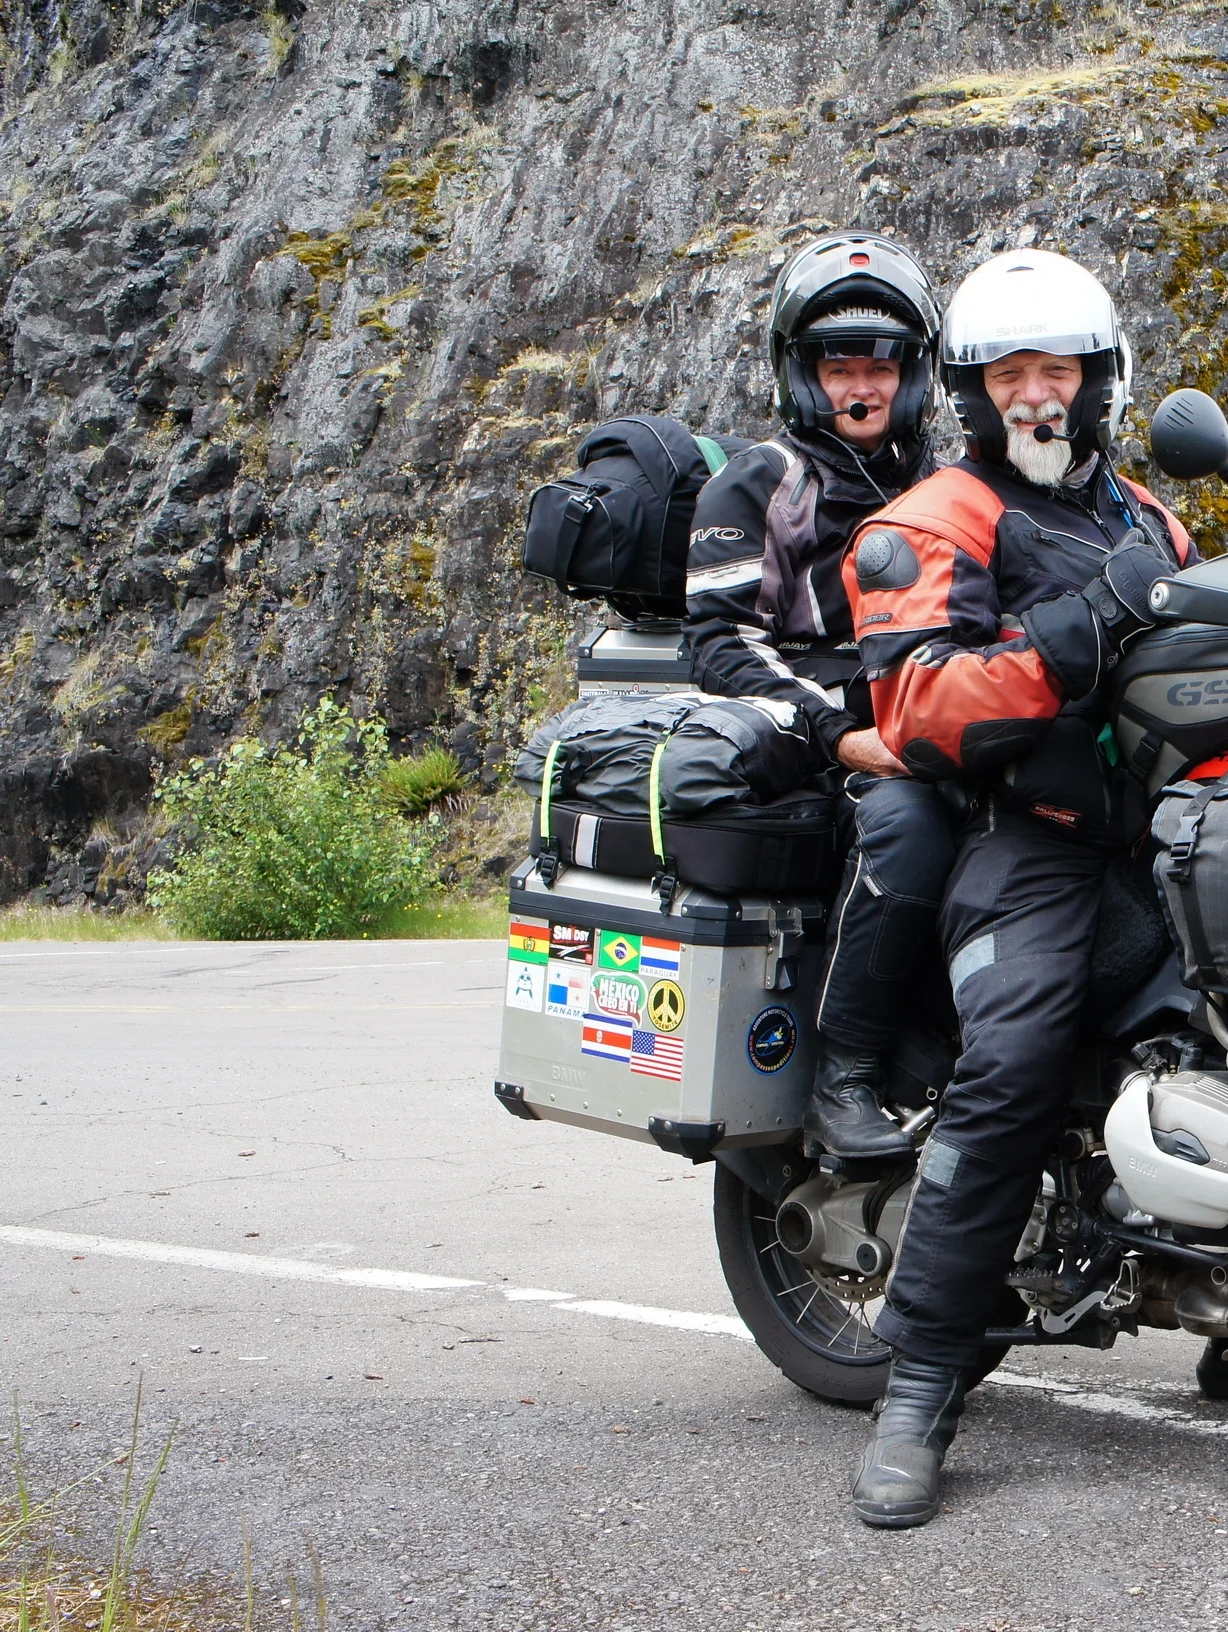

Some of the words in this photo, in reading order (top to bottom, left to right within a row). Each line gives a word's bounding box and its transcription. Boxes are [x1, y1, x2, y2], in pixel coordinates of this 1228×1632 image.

[996, 323, 1049, 338] SHARK
[640, 967, 677, 979] PARAGUAY
[599, 976, 640, 1002] MÉXICO
[598, 995, 618, 1011] CREO
[618, 999, 629, 1013] EN
[630, 1000, 639, 1014] TI
[652, 1014, 679, 1030] YOSEMITE
[752, 1010, 768, 1031] ADVENTURE
[552, 1064, 587, 1085] BMW
[1128, 1155, 1158, 1178] BMW
